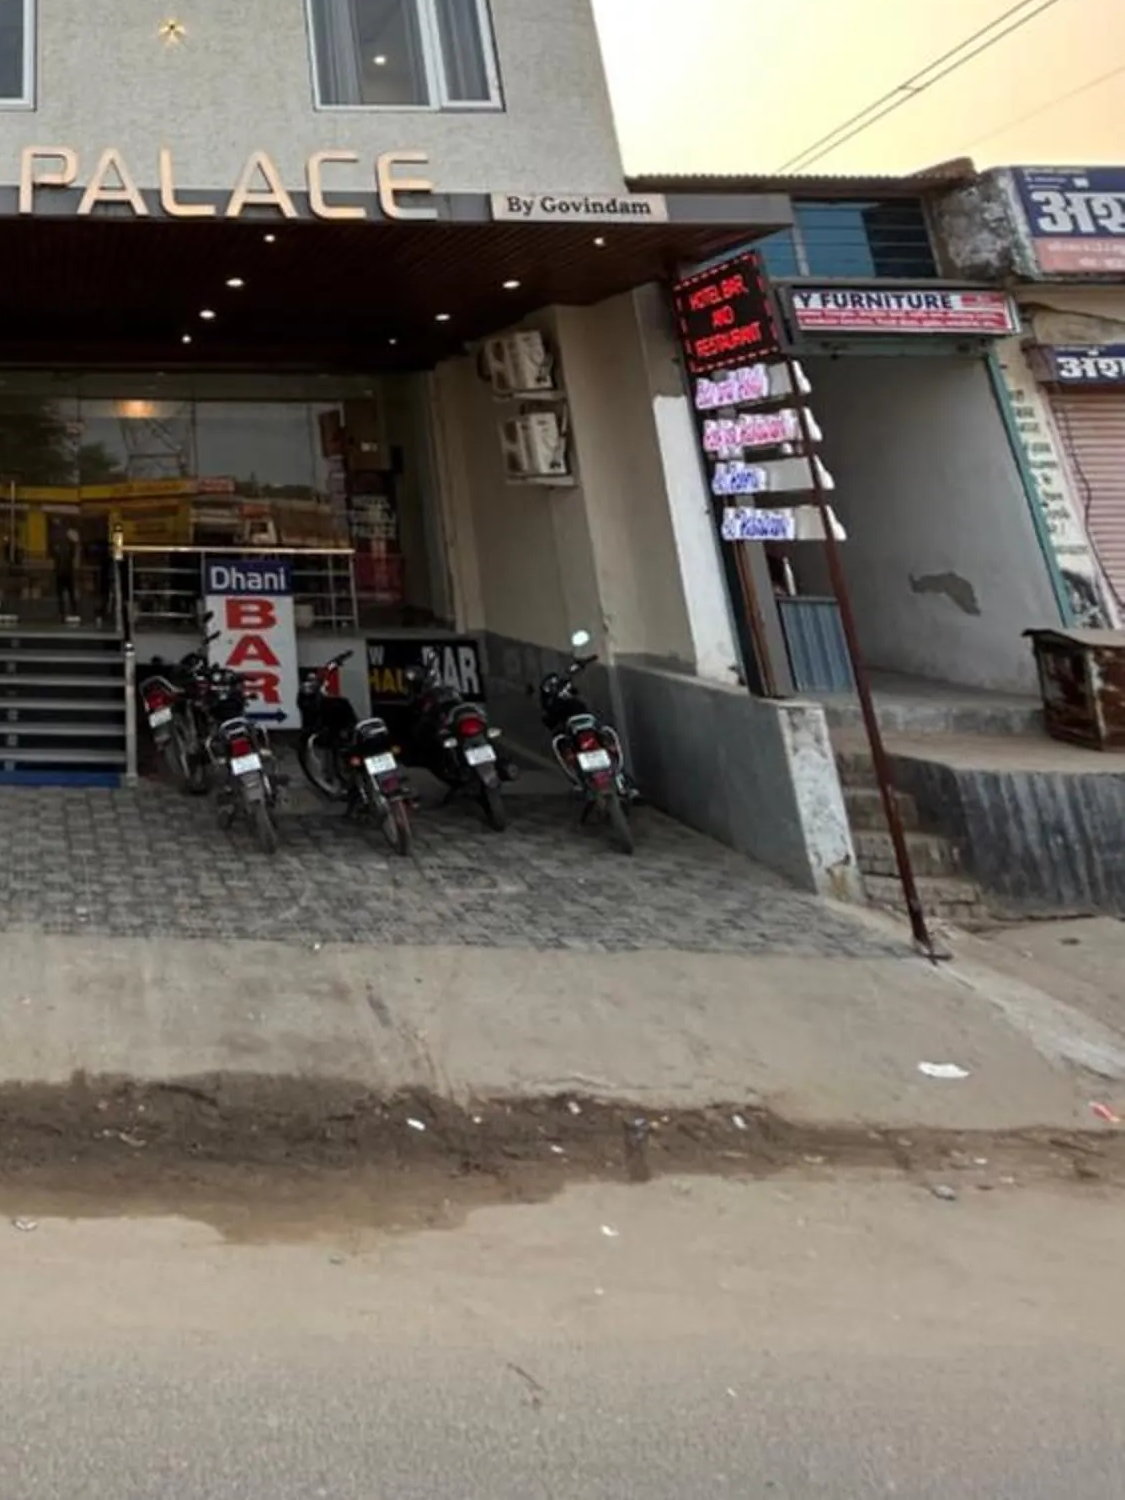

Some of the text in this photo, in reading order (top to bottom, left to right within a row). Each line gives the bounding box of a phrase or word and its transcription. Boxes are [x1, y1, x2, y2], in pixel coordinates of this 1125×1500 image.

[17, 145, 439, 221] PALACE
[506, 196, 652, 217] By Govindam
[823, 292, 954, 310] FURNITURE
[210, 565, 287, 591] Dhani
